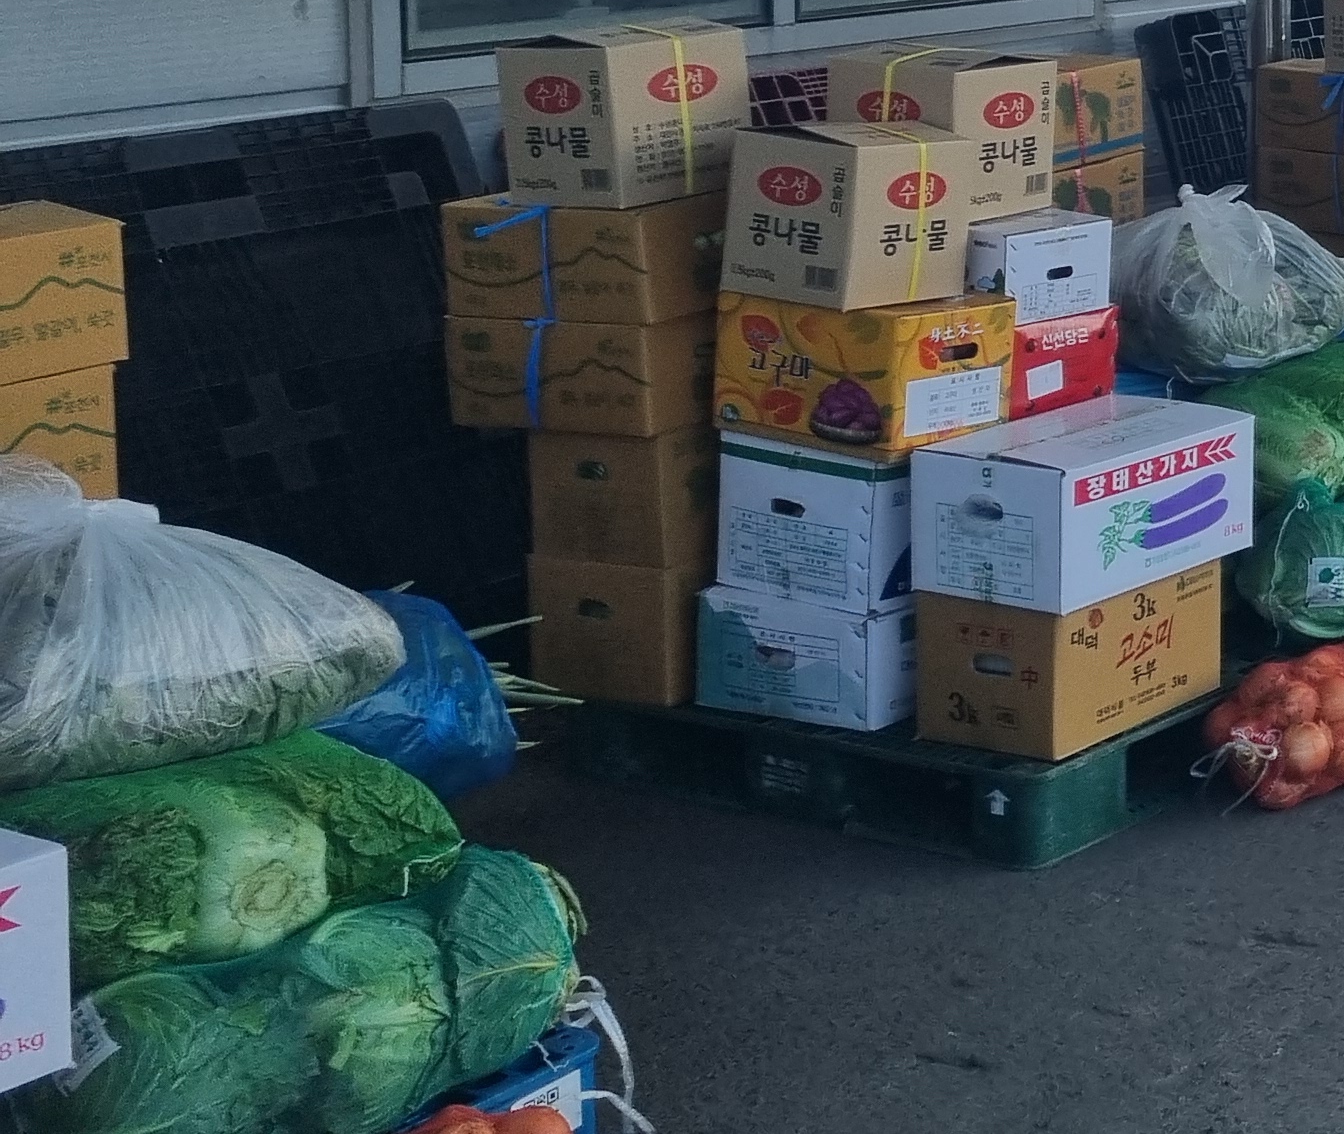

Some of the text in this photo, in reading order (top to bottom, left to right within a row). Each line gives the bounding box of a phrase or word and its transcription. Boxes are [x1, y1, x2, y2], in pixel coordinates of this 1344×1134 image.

[535, 81, 569, 108] 수성
[661, 68, 703, 99] 수성
[993, 96, 1026, 124] 수성
[524, 125, 591, 159] 콩나물
[978, 136, 1038, 174] 콩나물
[770, 173, 809, 201] 수성
[899, 177, 935, 205] 수성
[748, 212, 823, 256] 콩나물
[879, 219, 948, 257] 콩나물
[1041, 328, 1089, 351] 신선당근
[748, 346, 812, 388] 고구마
[1087, 447, 1200, 500] 장태산가지
[1070, 627, 1098, 650] 대덕
[1115, 614, 1174, 669] 고소미
[1130, 659, 1157, 686] 두부
